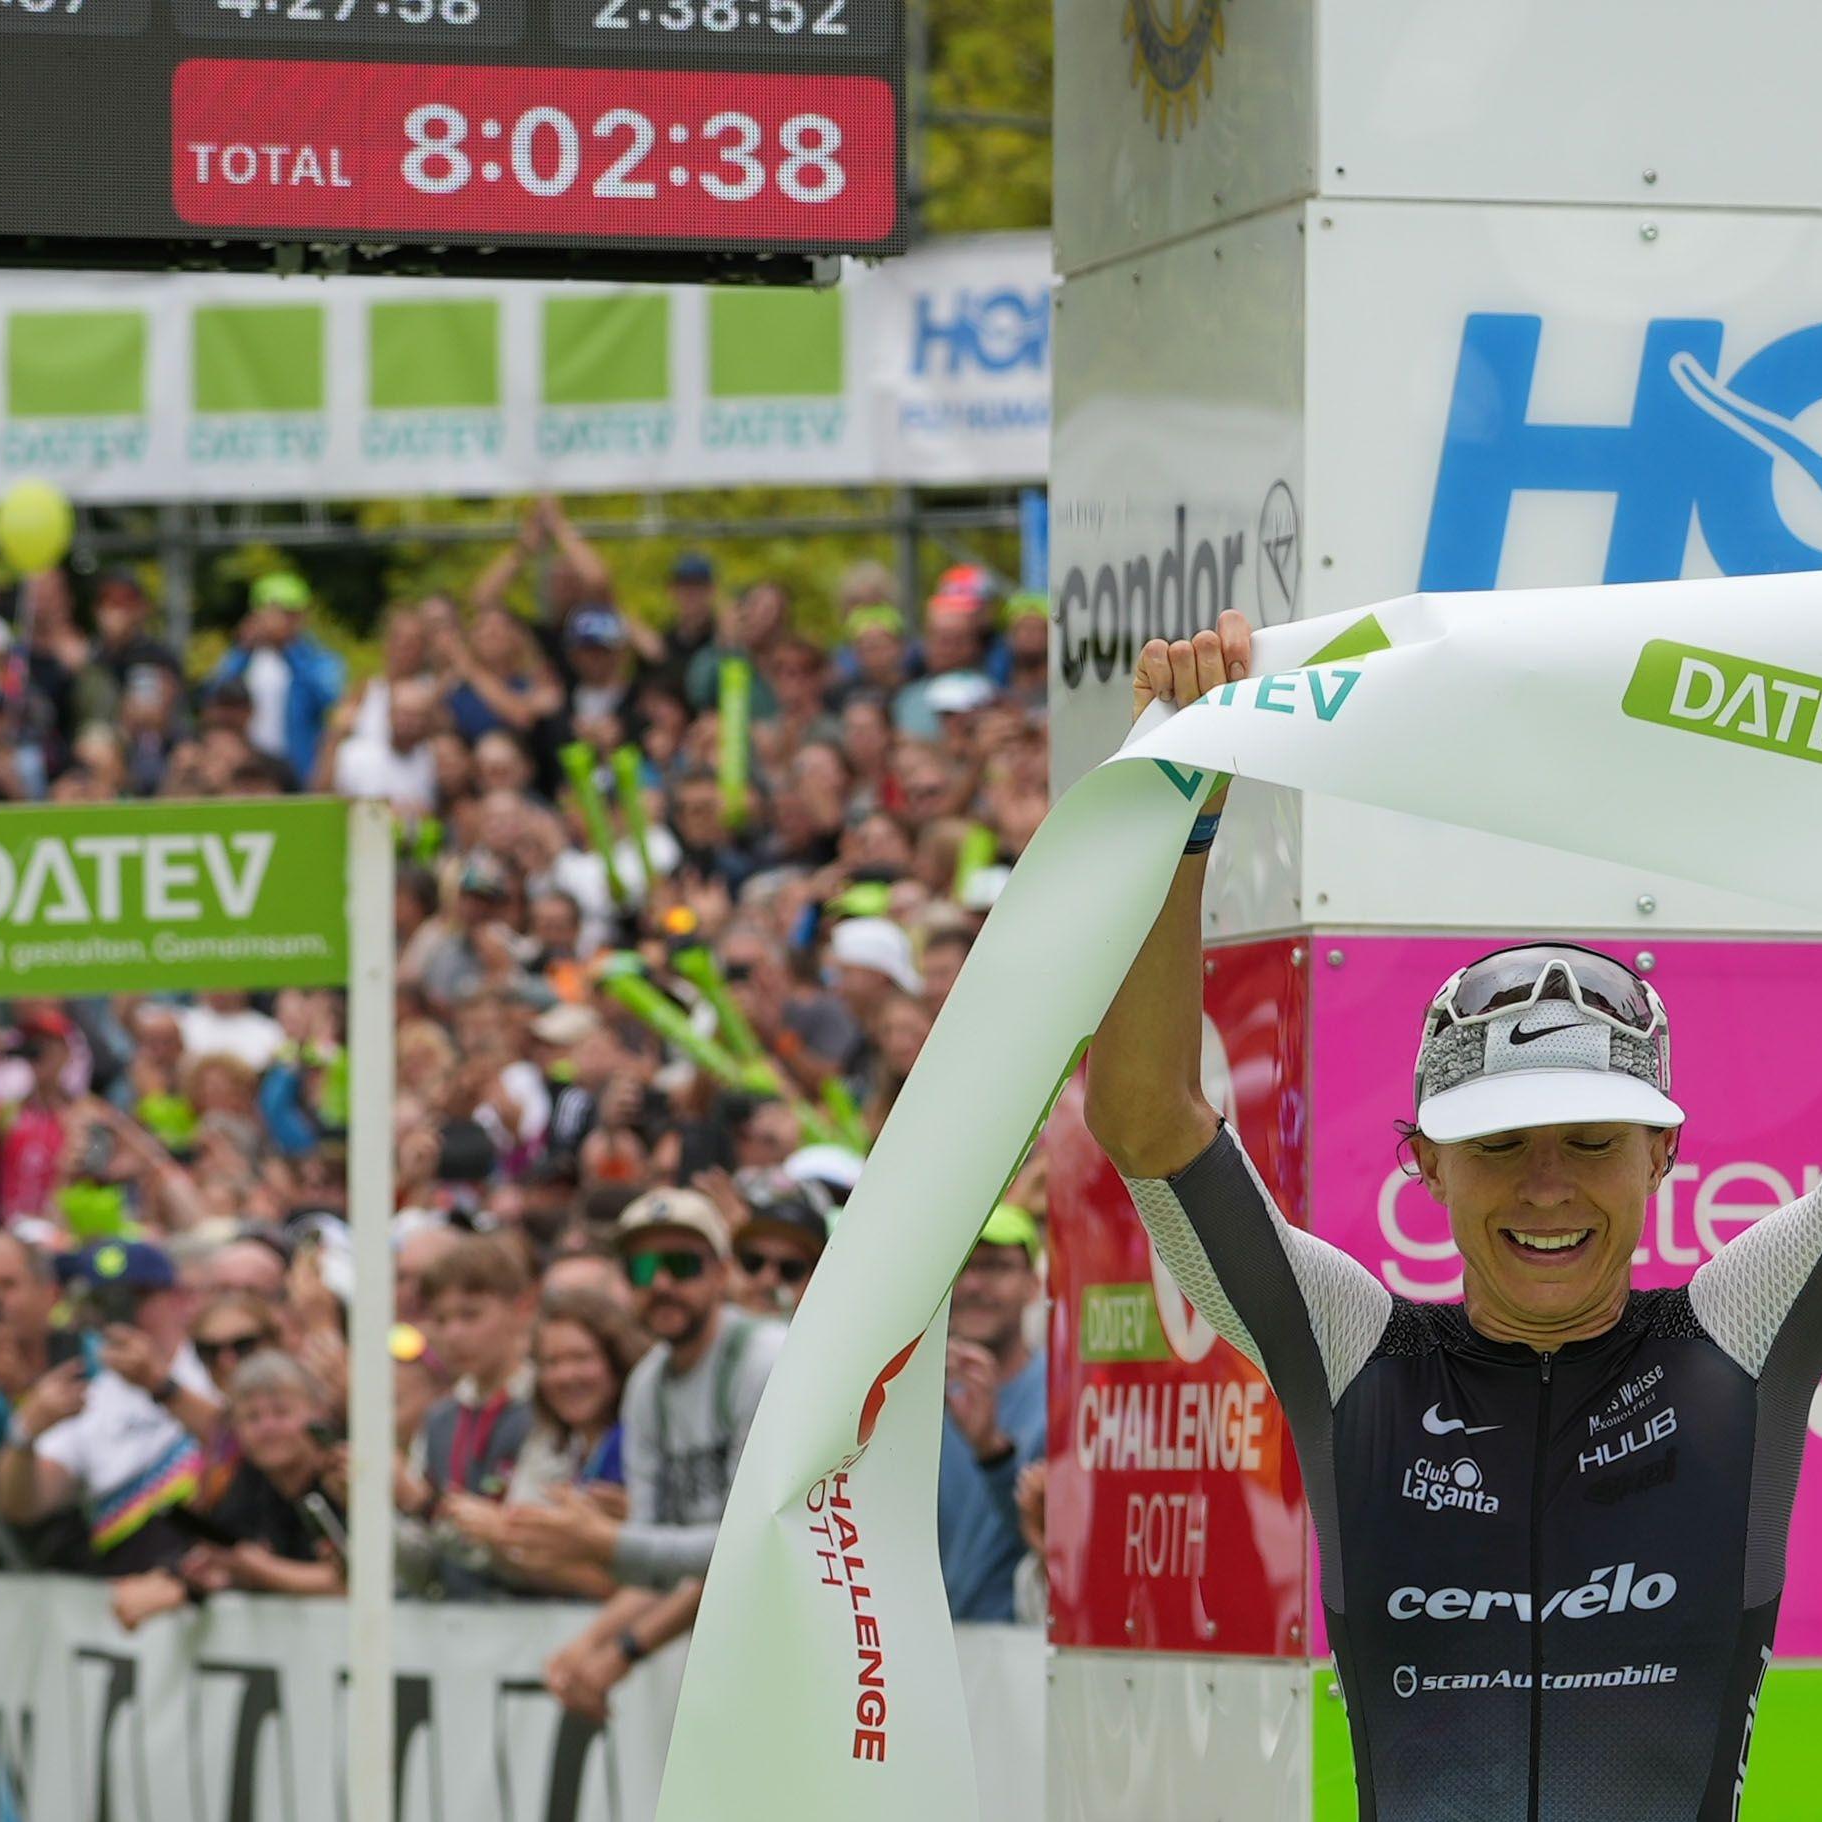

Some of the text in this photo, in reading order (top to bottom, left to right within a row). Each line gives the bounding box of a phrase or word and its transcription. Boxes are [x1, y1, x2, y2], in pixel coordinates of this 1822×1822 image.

[188, 102, 845, 204] TOTAL 8:02:38
[1057, 503, 1244, 690] condor
[1078, 1381, 1266, 1472] CHALLENGE
[1415, 1456, 1451, 1483] Club
[1577, 1406, 1677, 1474] HUUB
[807, 1476, 844, 1587] OTH
[1124, 1492, 1209, 1578] ROTH
[828, 1463, 888, 1763] HALLENGE
[1387, 1562, 1677, 1623] cervélo
[1421, 1662, 1678, 1690] scanAutomobile
